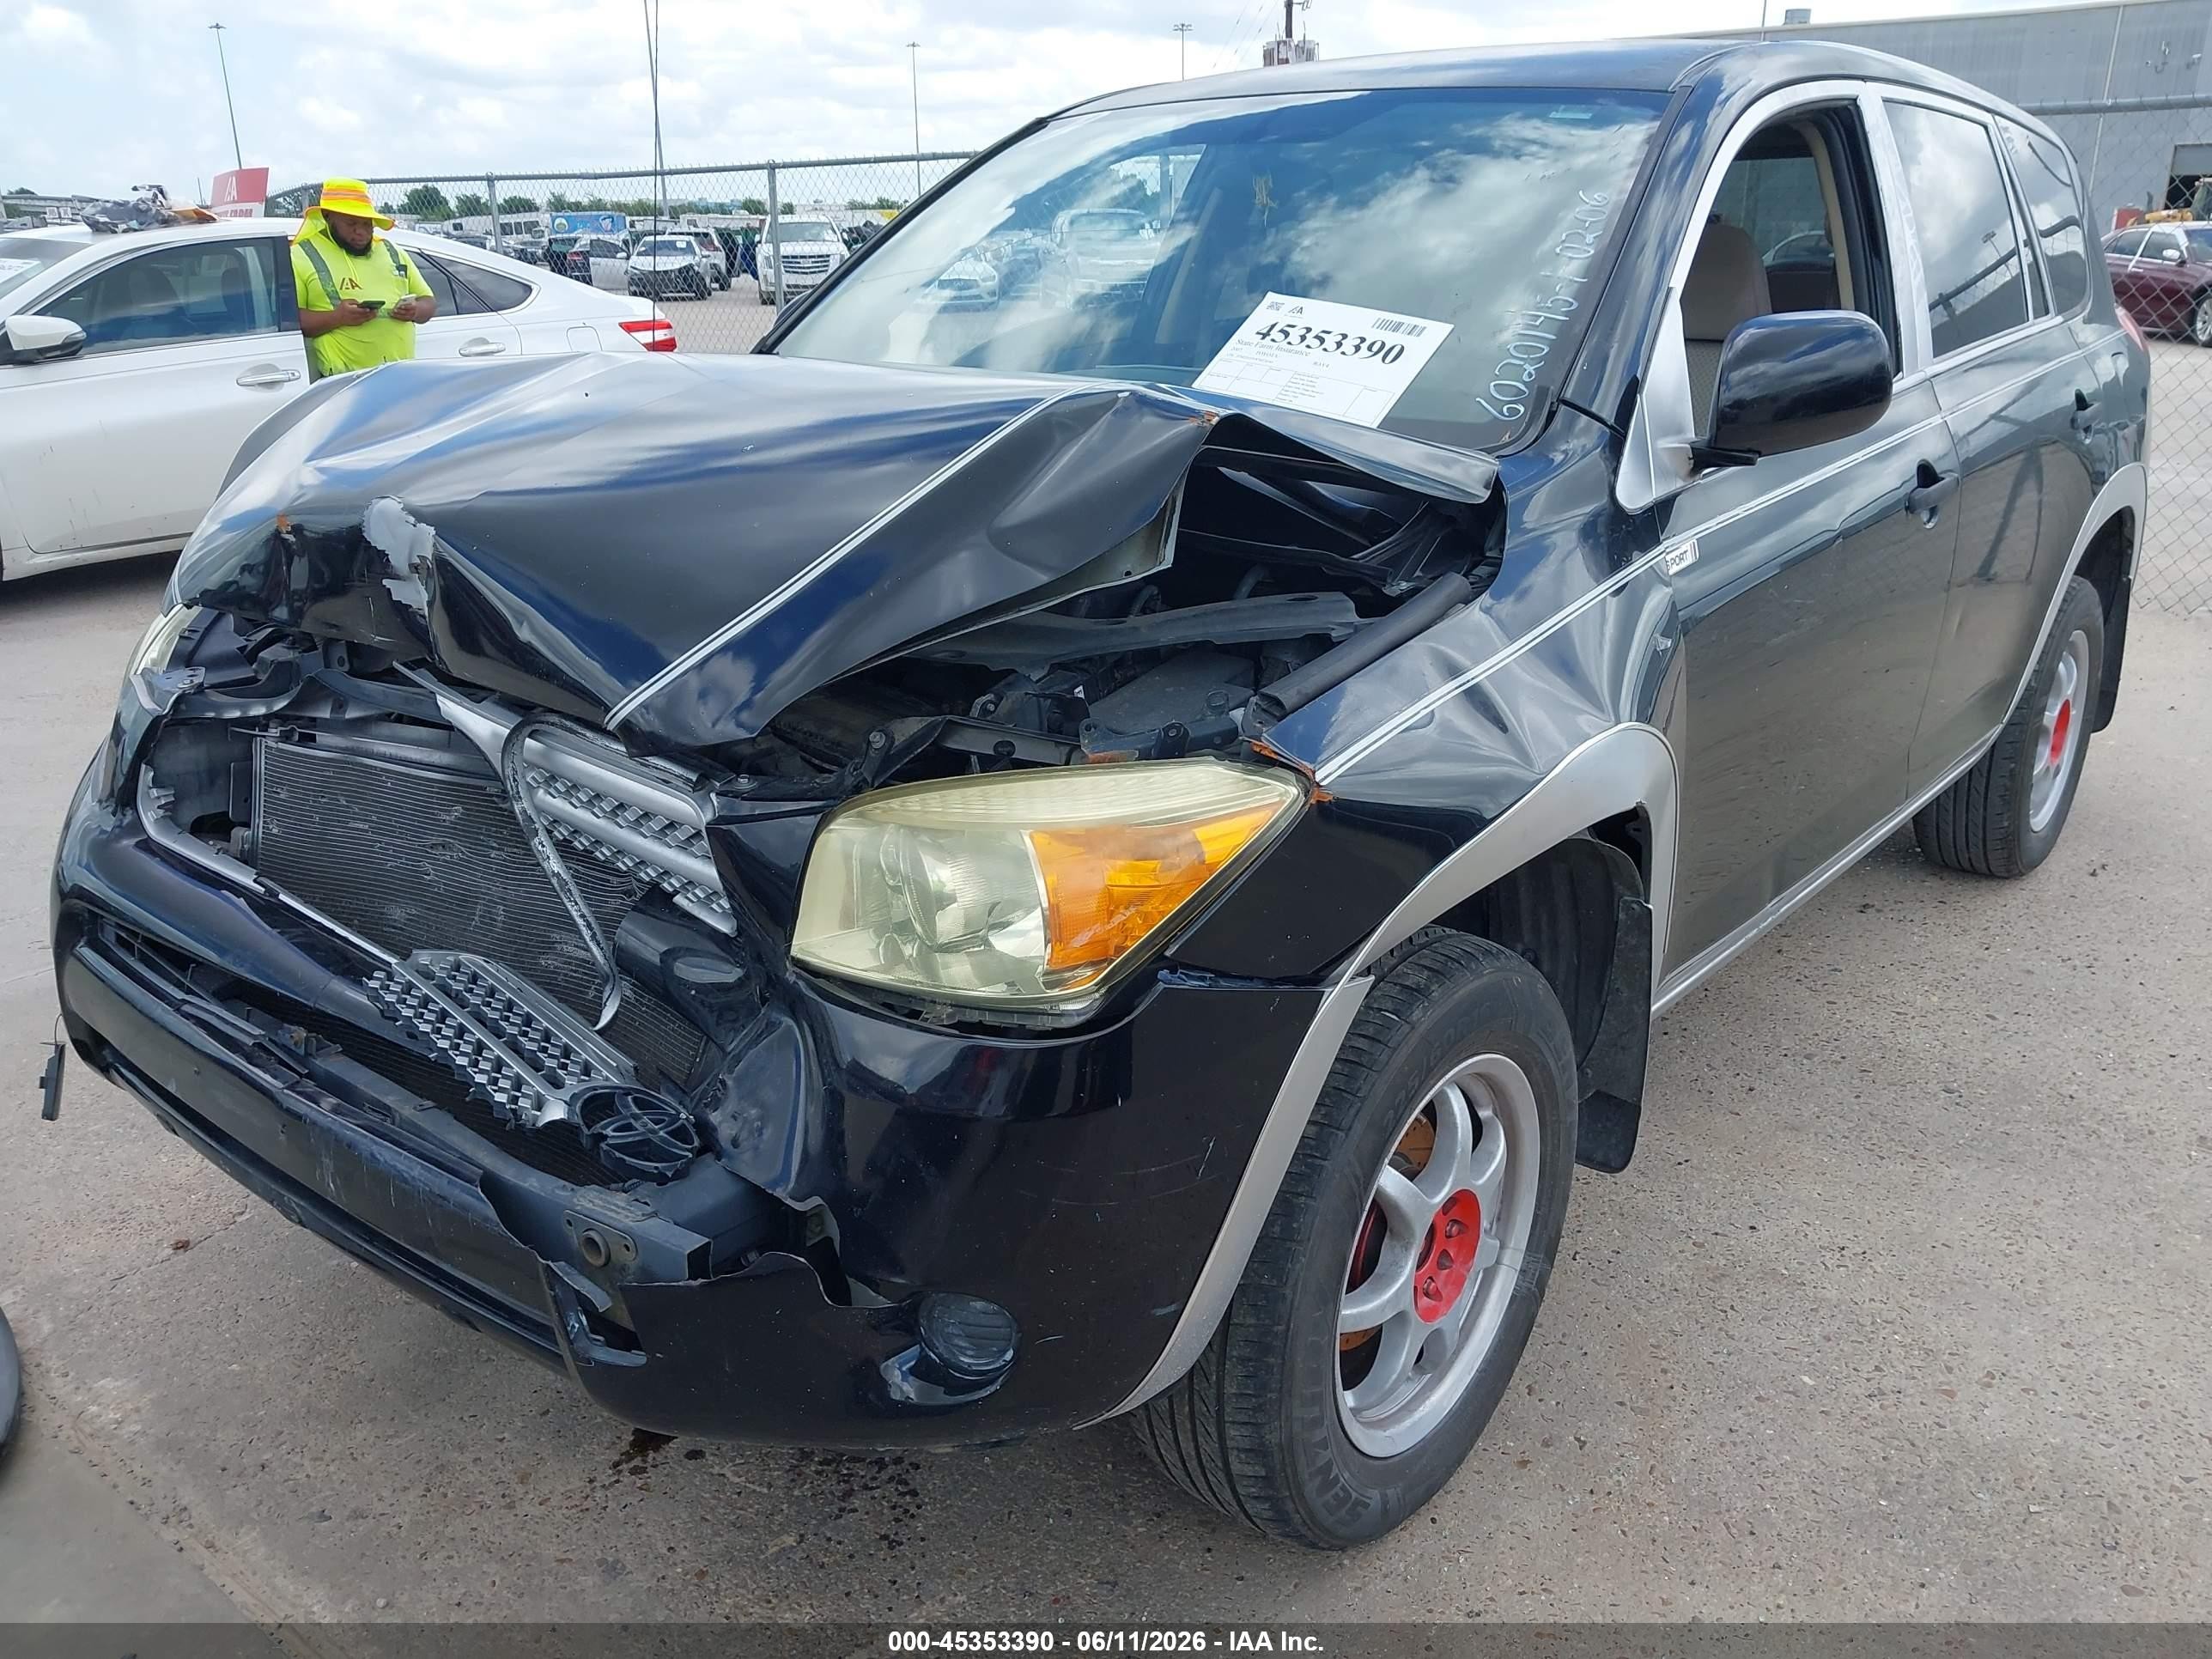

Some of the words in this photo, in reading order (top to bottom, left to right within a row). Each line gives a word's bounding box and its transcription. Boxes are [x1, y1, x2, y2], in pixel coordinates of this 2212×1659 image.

[1235, 338, 1254, 347] State
[1255, 342, 1274, 350] Farm
[1275, 343, 1311, 357] Insurance
[1255, 320, 1406, 366] 45353390
